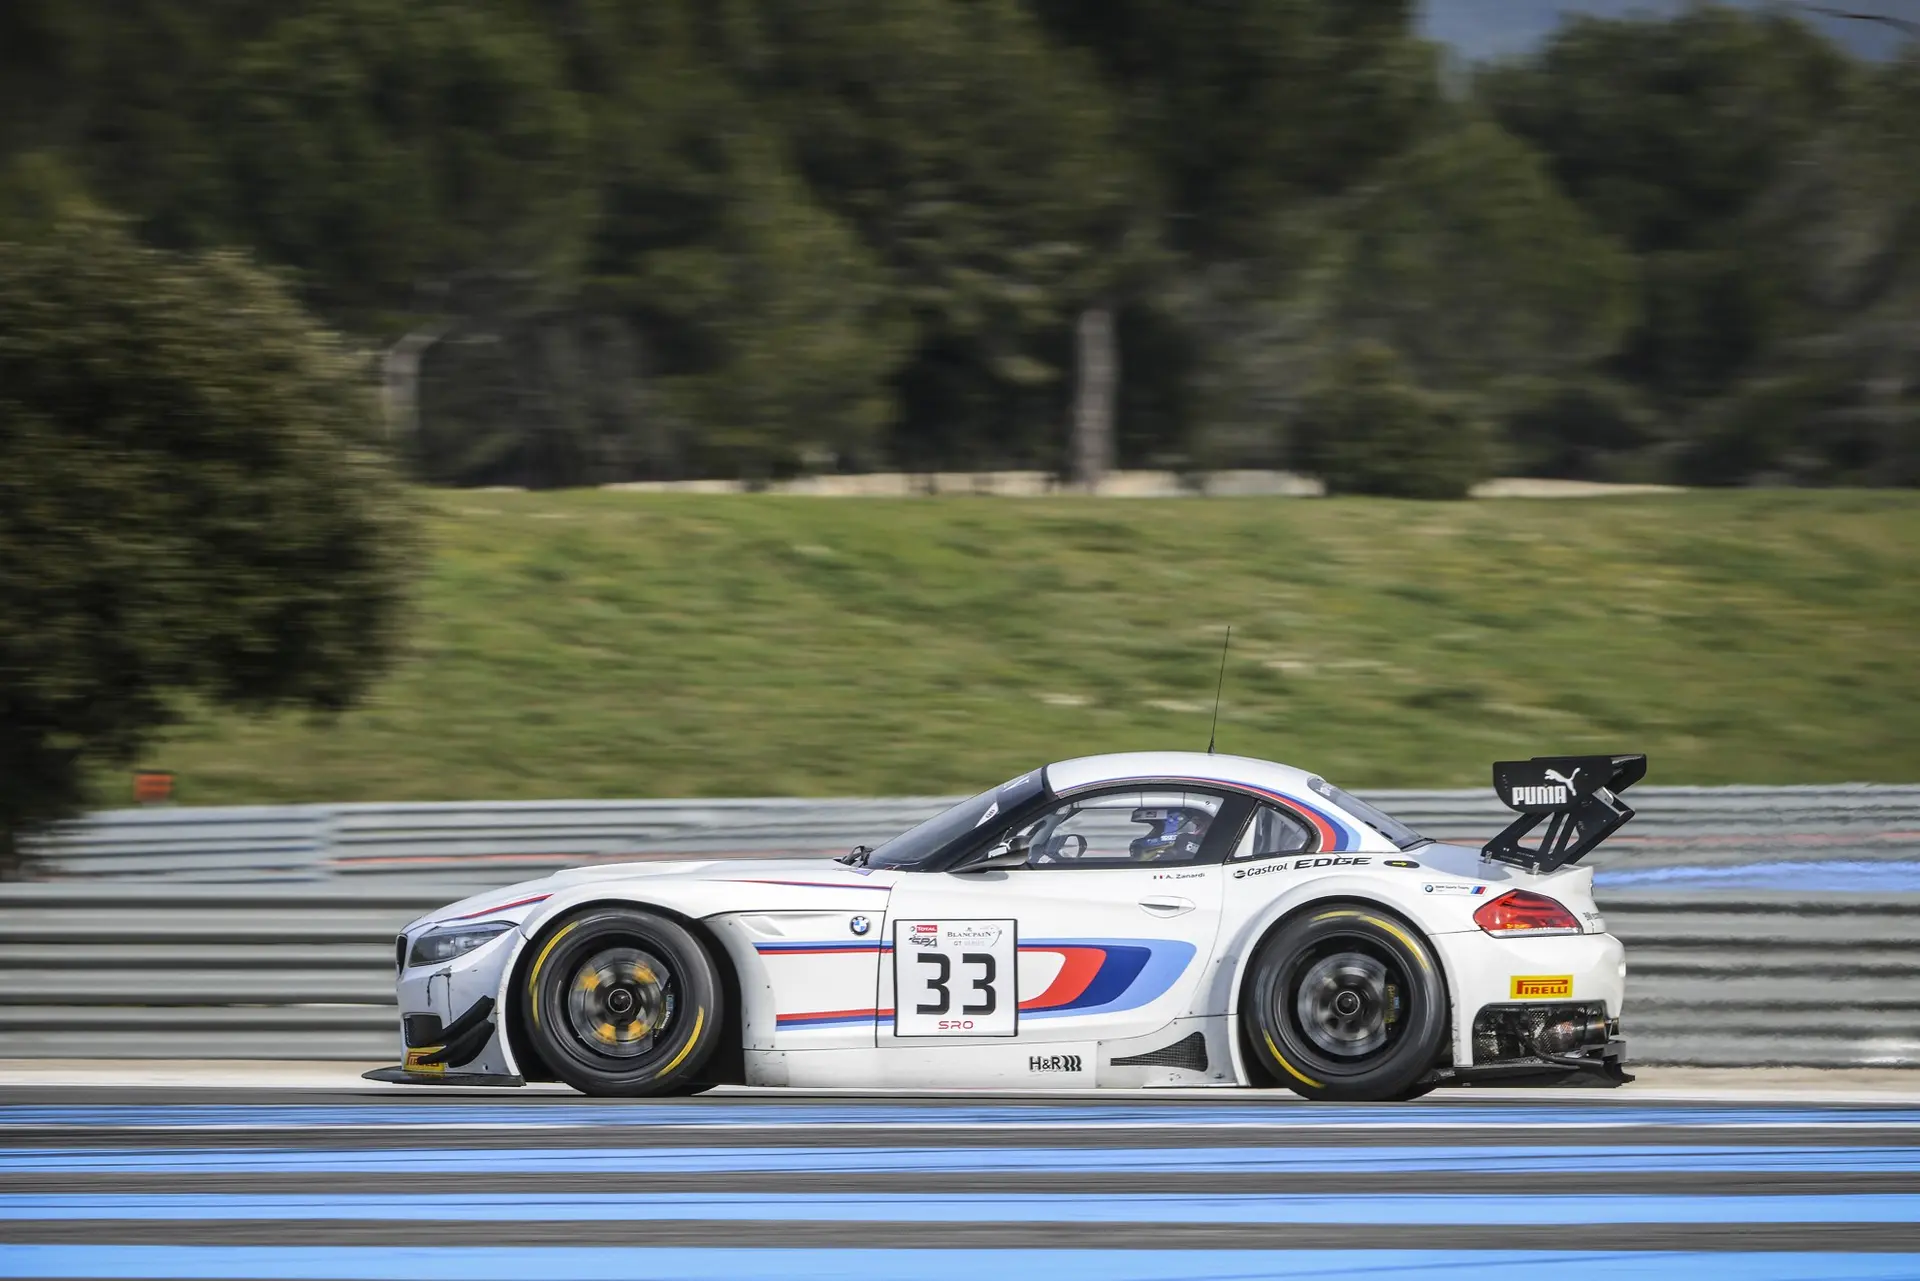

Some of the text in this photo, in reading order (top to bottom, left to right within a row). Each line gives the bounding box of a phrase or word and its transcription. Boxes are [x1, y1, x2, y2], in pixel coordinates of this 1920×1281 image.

[1512, 785, 1567, 806] PUMA
[1247, 857, 1372, 877] Castrol EDGE
[916, 952, 996, 1015] 33
[1516, 979, 1568, 995] PIRELLI
[938, 1020, 974, 1029] SRO
[1029, 1055, 1061, 1070] H&R
